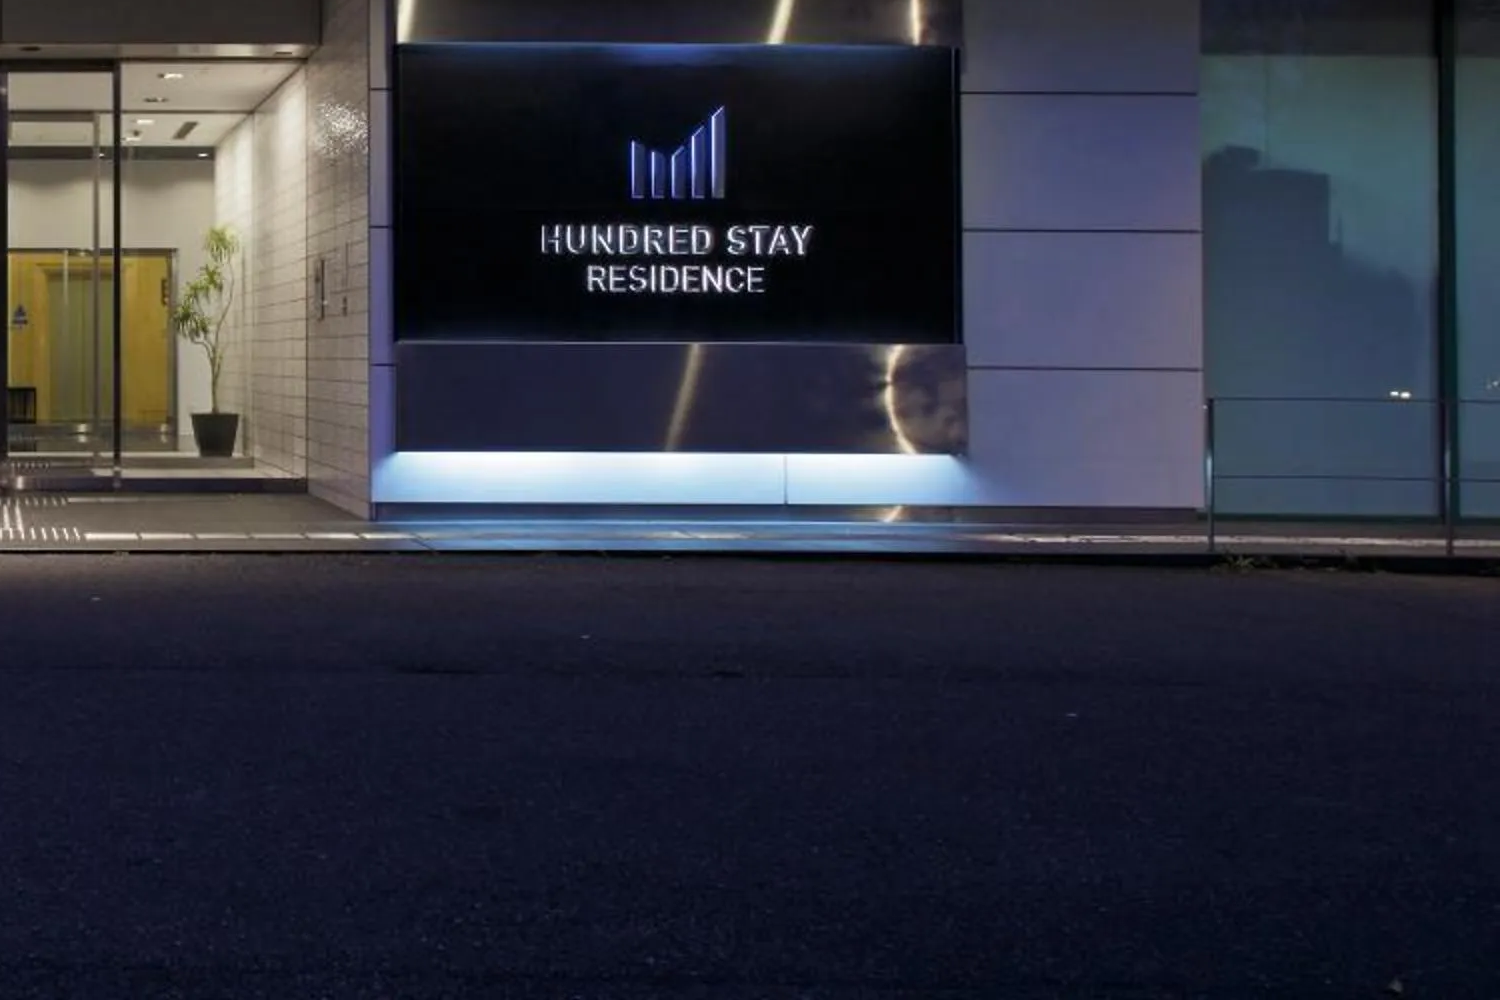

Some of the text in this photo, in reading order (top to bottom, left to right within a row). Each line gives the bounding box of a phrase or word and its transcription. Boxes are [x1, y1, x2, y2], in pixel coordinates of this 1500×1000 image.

[541, 224, 814, 256] HUNDRED STAY
[587, 264, 765, 294] RESIDENCE
